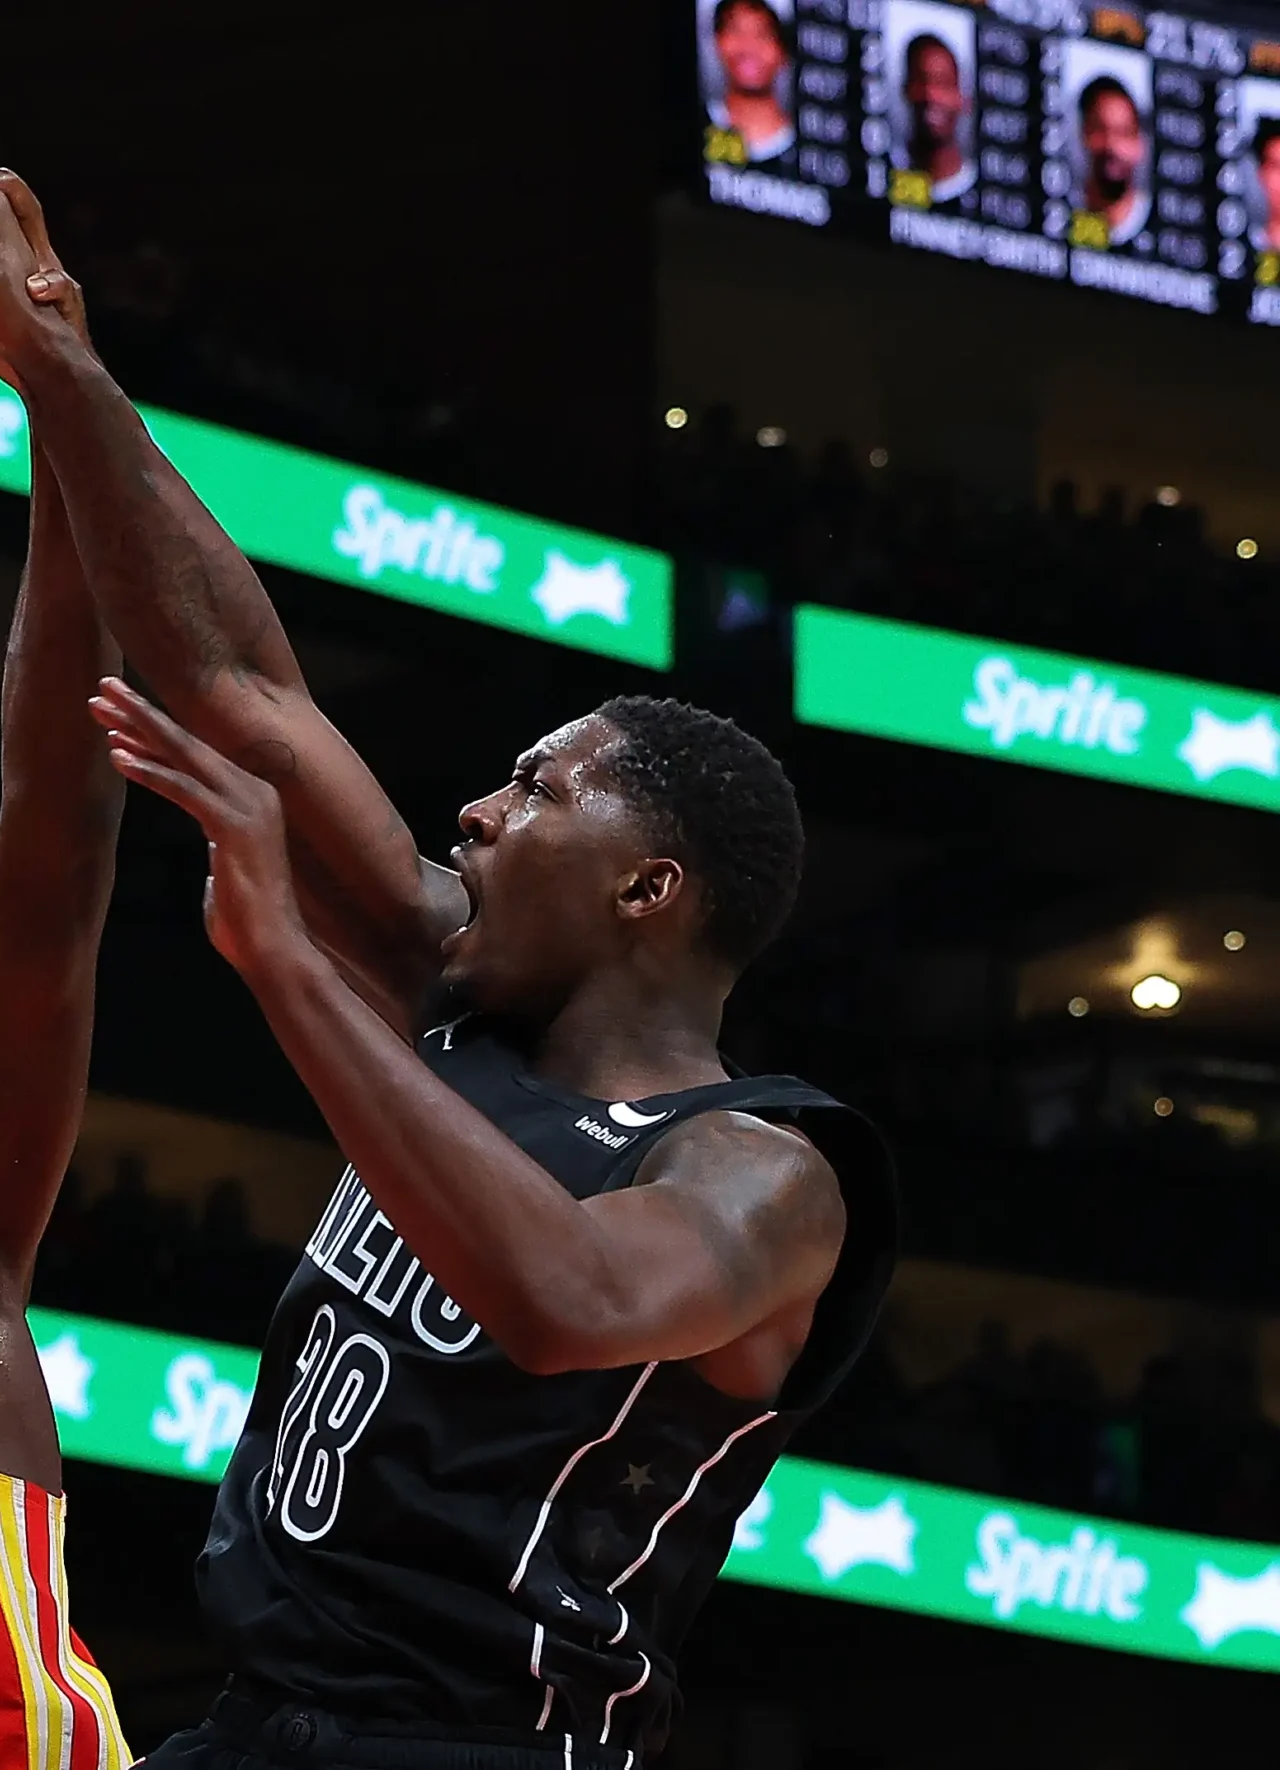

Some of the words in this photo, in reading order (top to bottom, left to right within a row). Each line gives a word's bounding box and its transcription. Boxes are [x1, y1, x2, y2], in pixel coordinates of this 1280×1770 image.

[335, 486, 504, 592] Sprite
[965, 658, 1145, 754] Sprite
[575, 1115, 629, 1150] Webull
[967, 1513, 1147, 1619] Sprite
